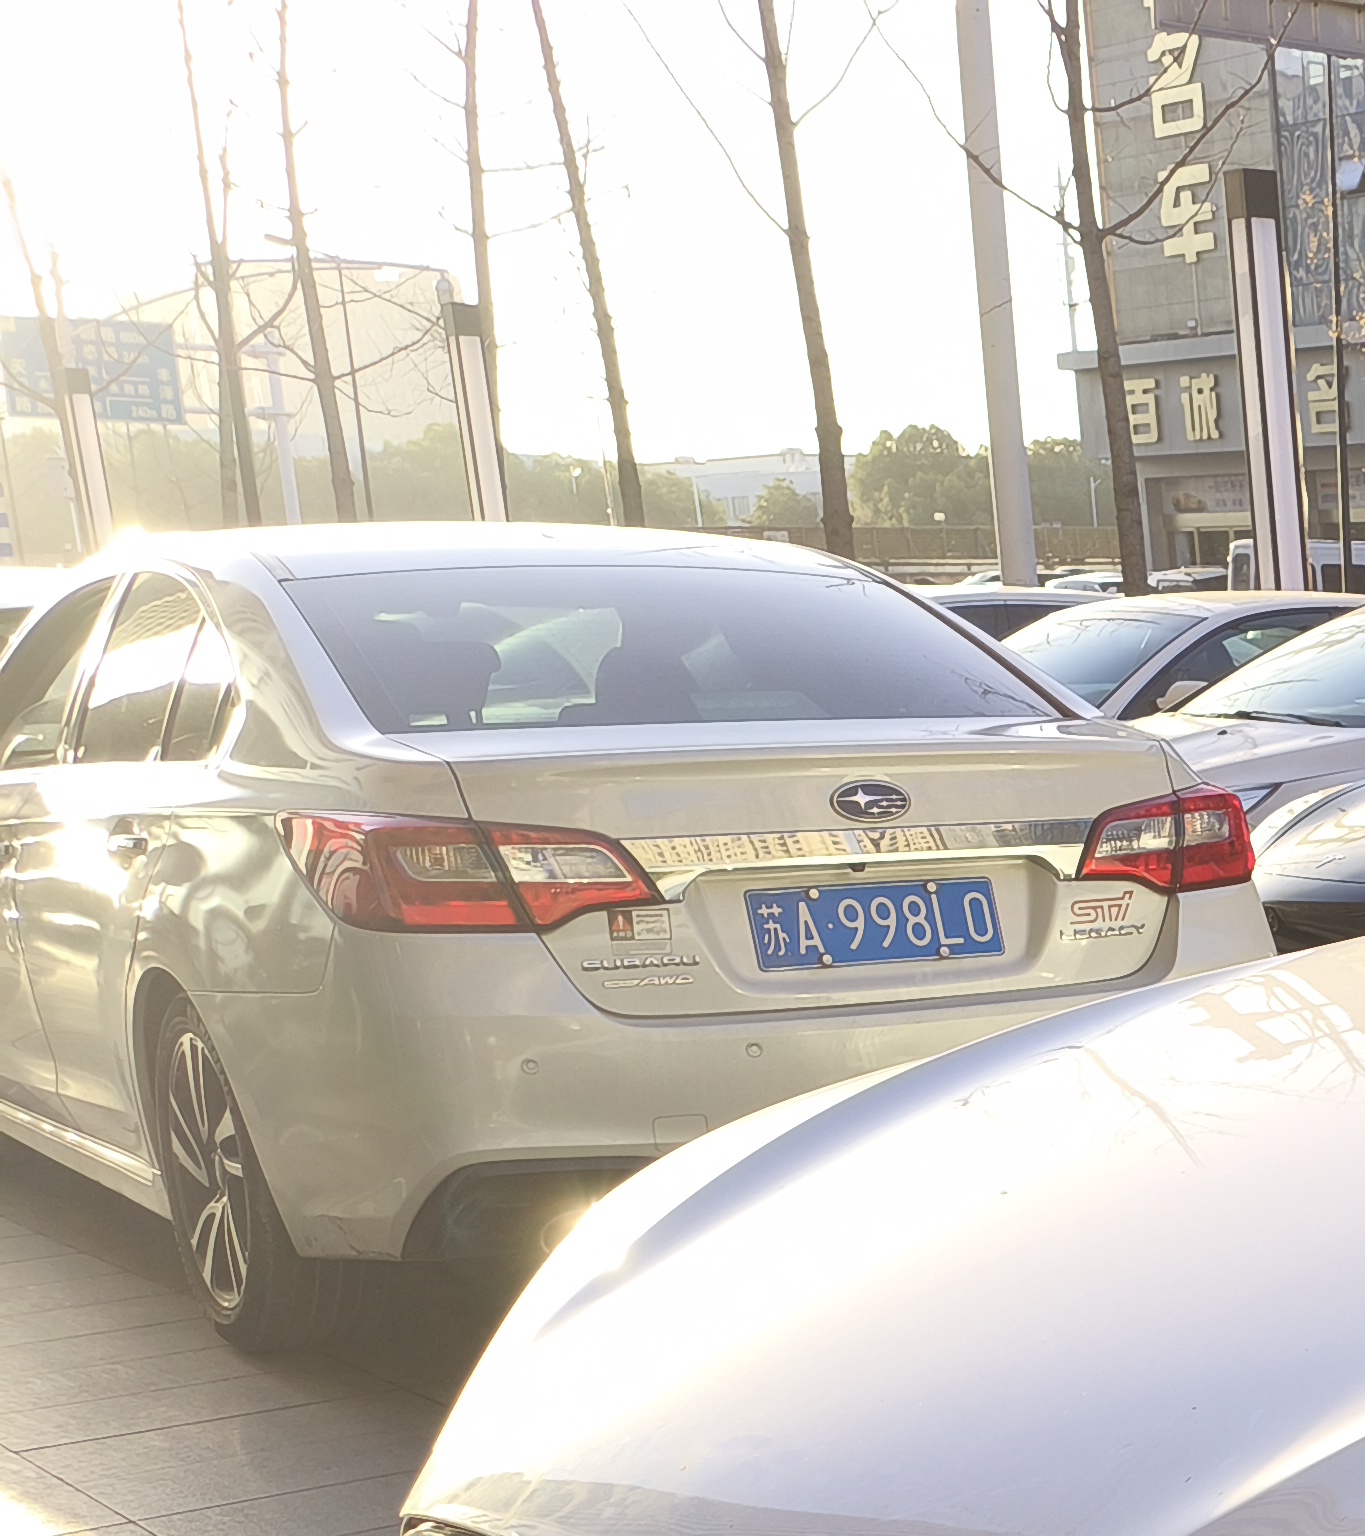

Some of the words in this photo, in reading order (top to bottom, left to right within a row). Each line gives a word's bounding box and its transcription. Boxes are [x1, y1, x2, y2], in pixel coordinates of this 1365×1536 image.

[1143, 0, 1216, 264] 名车
[1059, 923, 1146, 942] LEGACY
[581, 955, 700, 972] SUBARU
[639, 975, 695, 987] AWD
